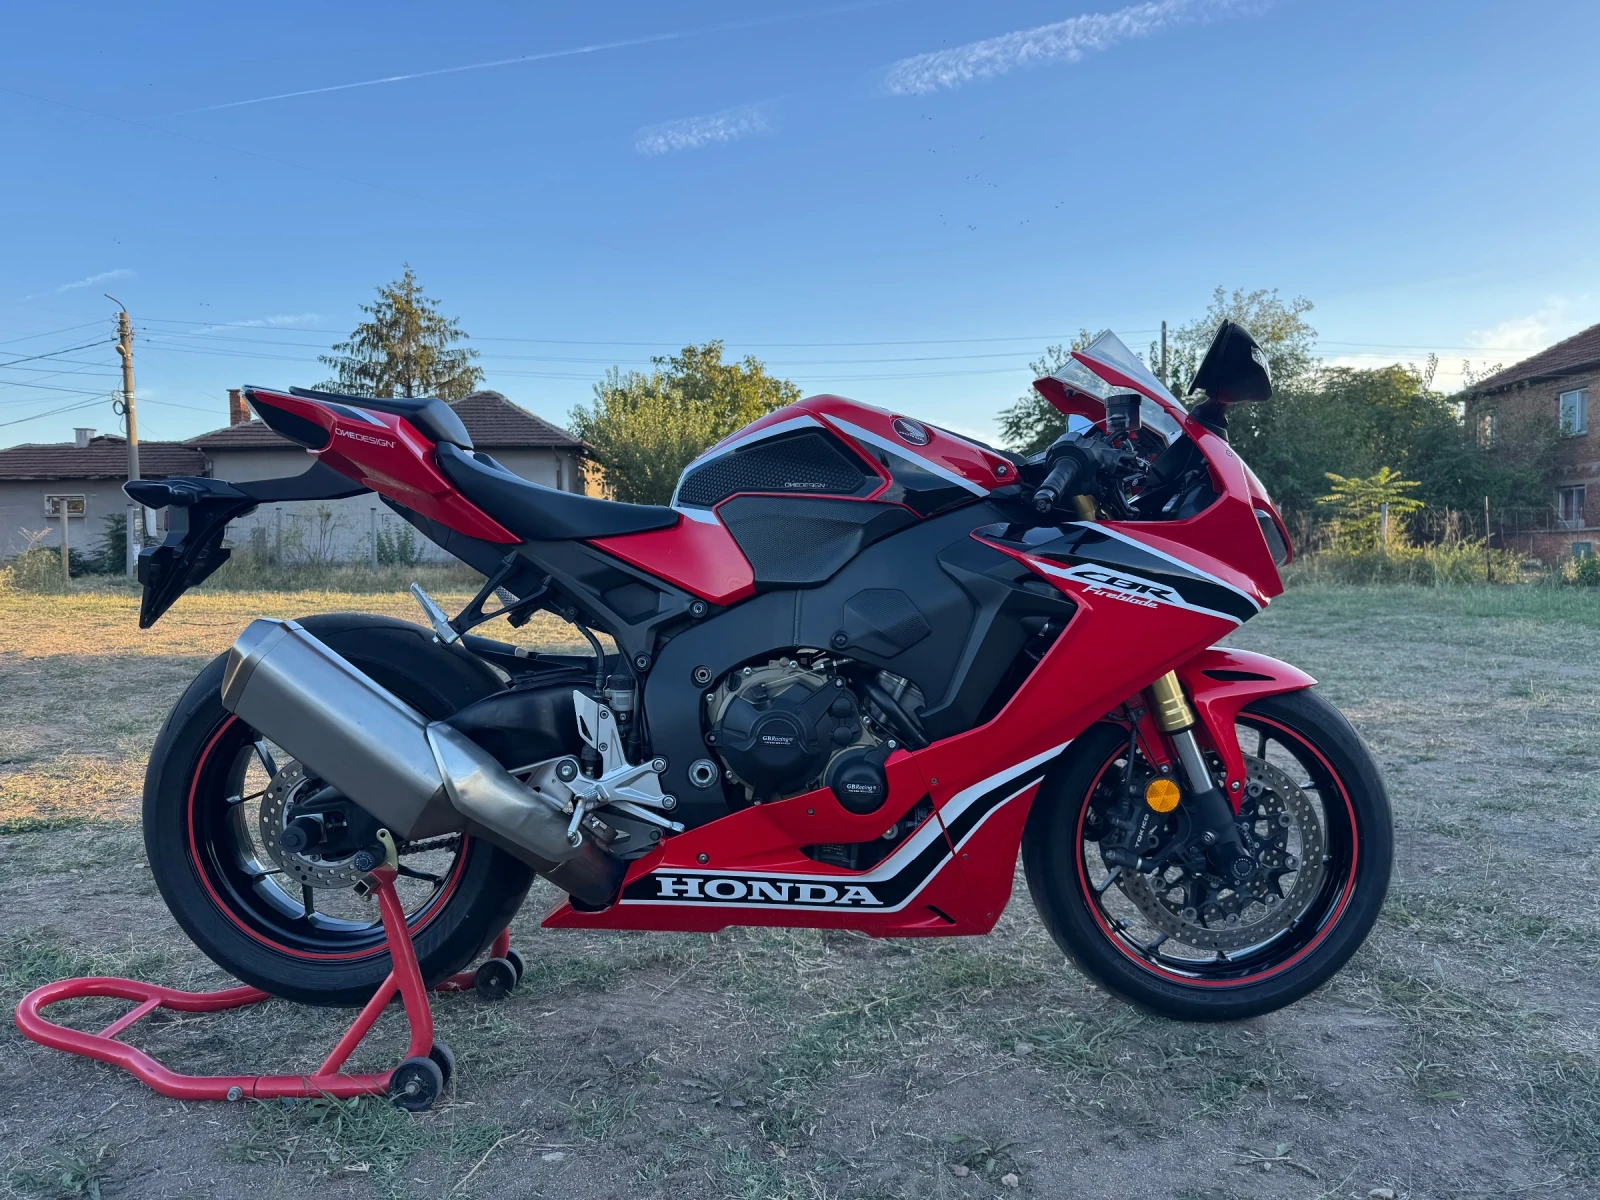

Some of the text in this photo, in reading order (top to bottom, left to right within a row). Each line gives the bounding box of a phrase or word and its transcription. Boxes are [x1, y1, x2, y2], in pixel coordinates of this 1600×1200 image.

[334, 427, 396, 449] ONEDESIGN
[1071, 571, 1176, 604] CBR
[1081, 584, 1158, 609] Fireblade
[1134, 813, 1150, 848] TOKICO
[655, 876, 884, 905] HONDA
